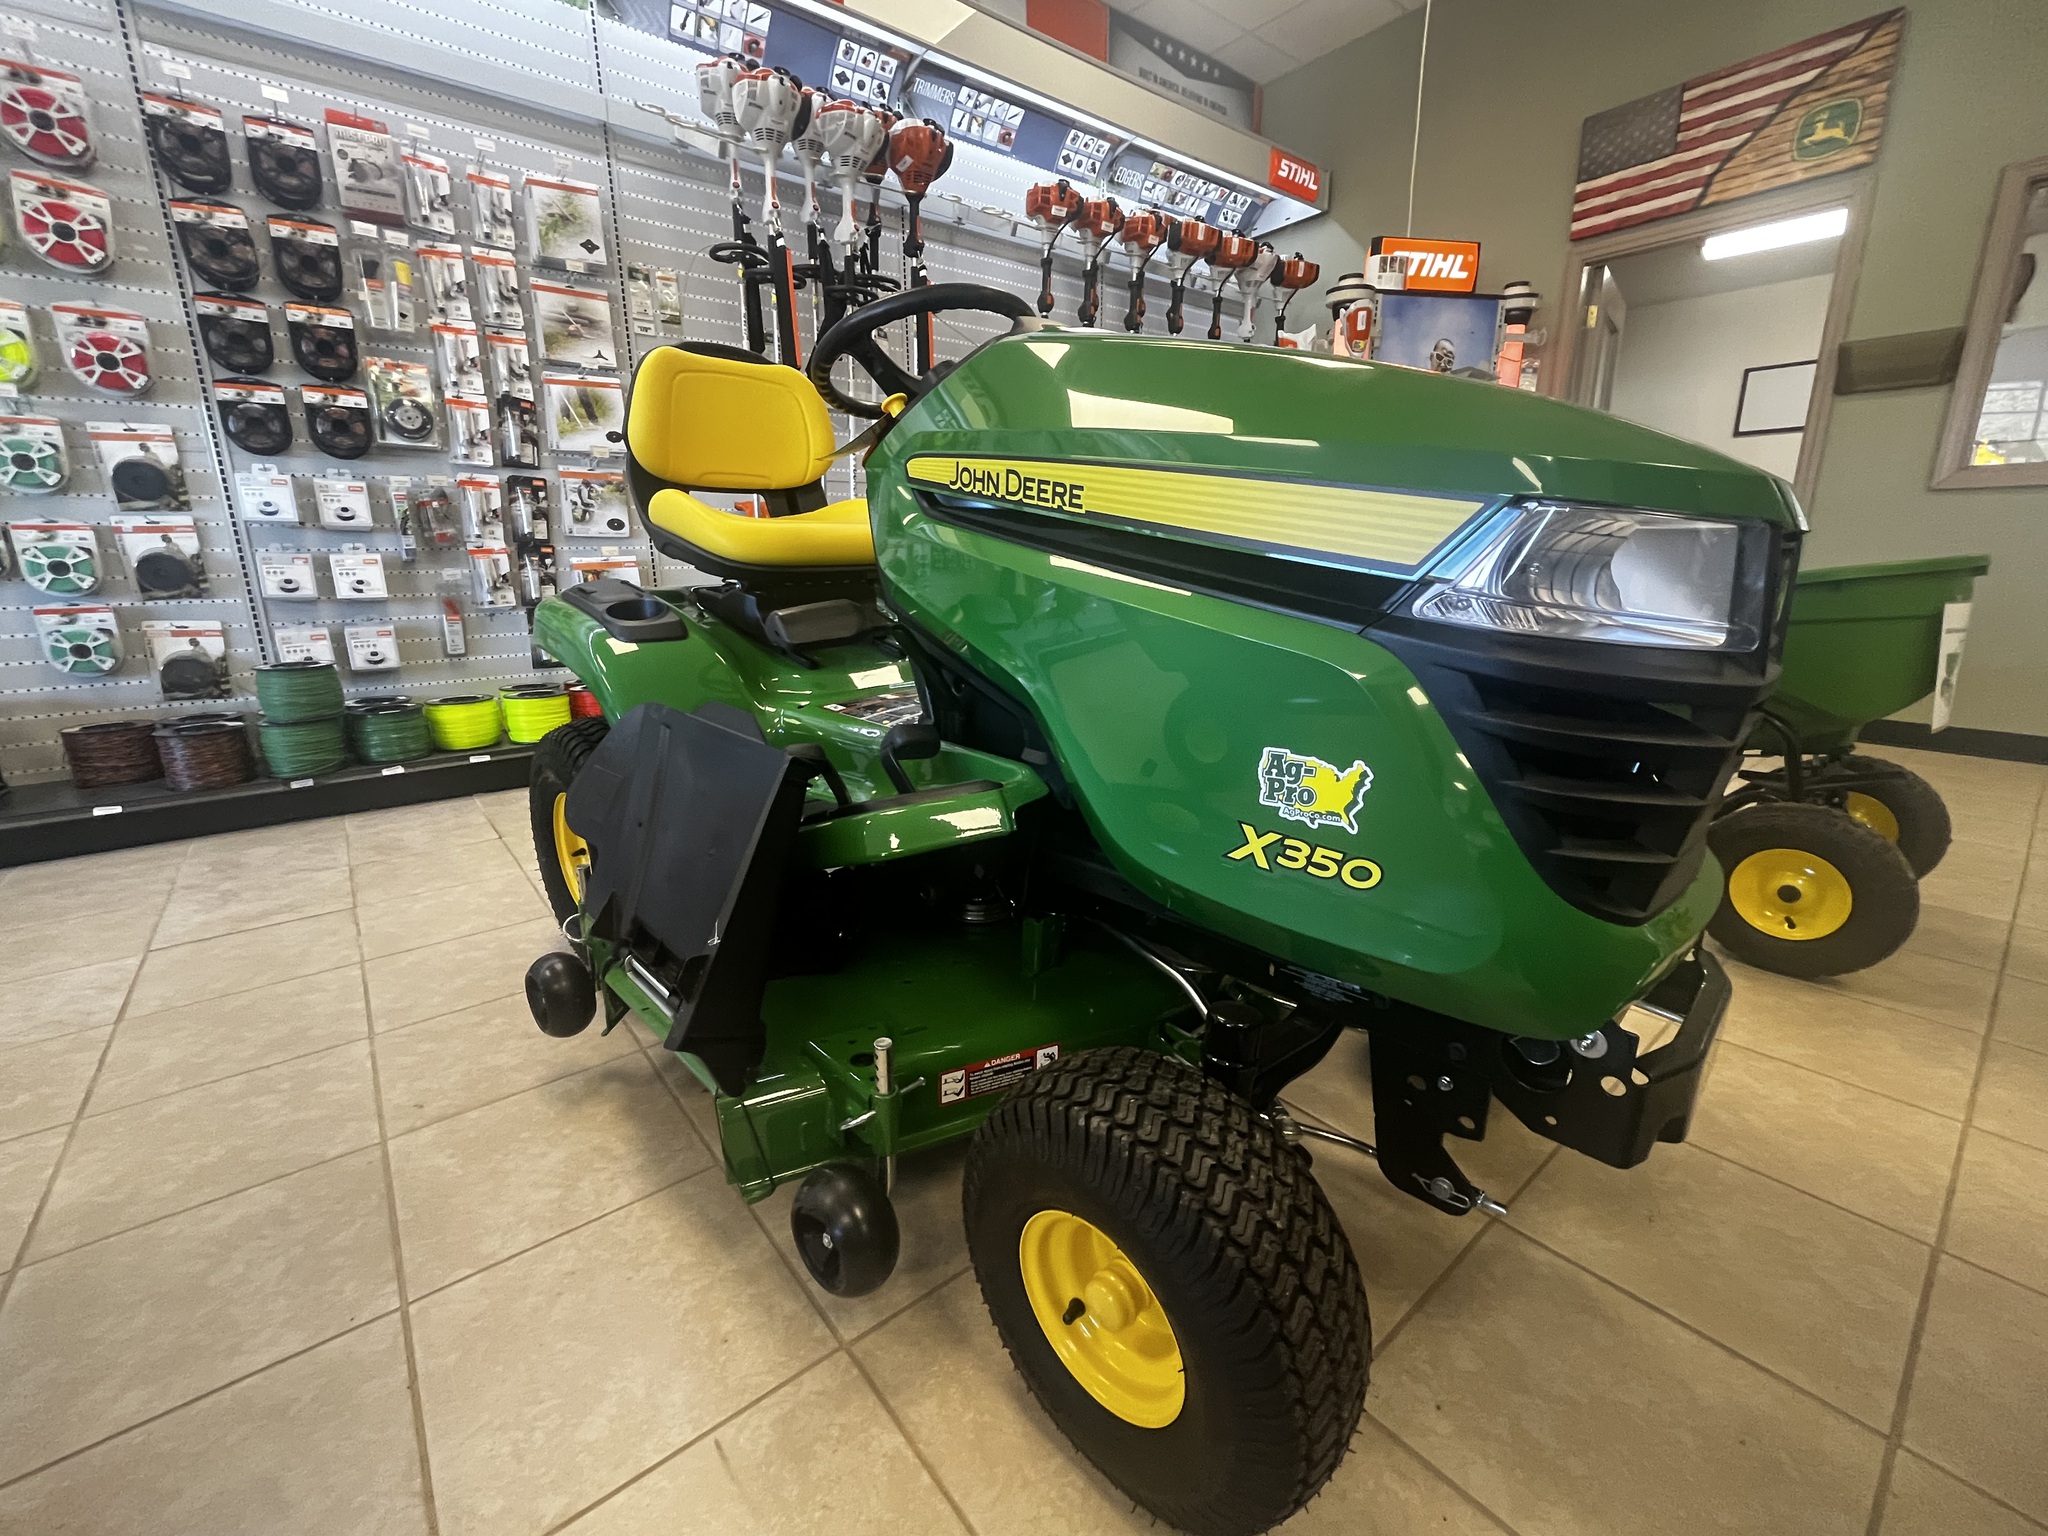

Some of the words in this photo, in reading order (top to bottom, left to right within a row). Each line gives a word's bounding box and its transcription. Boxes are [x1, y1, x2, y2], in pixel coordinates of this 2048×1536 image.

[913, 78, 957, 106] TRIMMERS
[1114, 166, 1145, 190] EDGERS
[1277, 158, 1318, 191] STIHL
[1393, 251, 1468, 279] TIHL
[949, 461, 1000, 495] JOHN
[1005, 468, 1085, 510] DEERE
[1264, 751, 1317, 785] Ag-
[1263, 777, 1317, 807] Pro
[1283, 807, 1342, 823] AgProCo.com
[1225, 821, 1383, 890] X350
[991, 1052, 1021, 1067] DANGER
